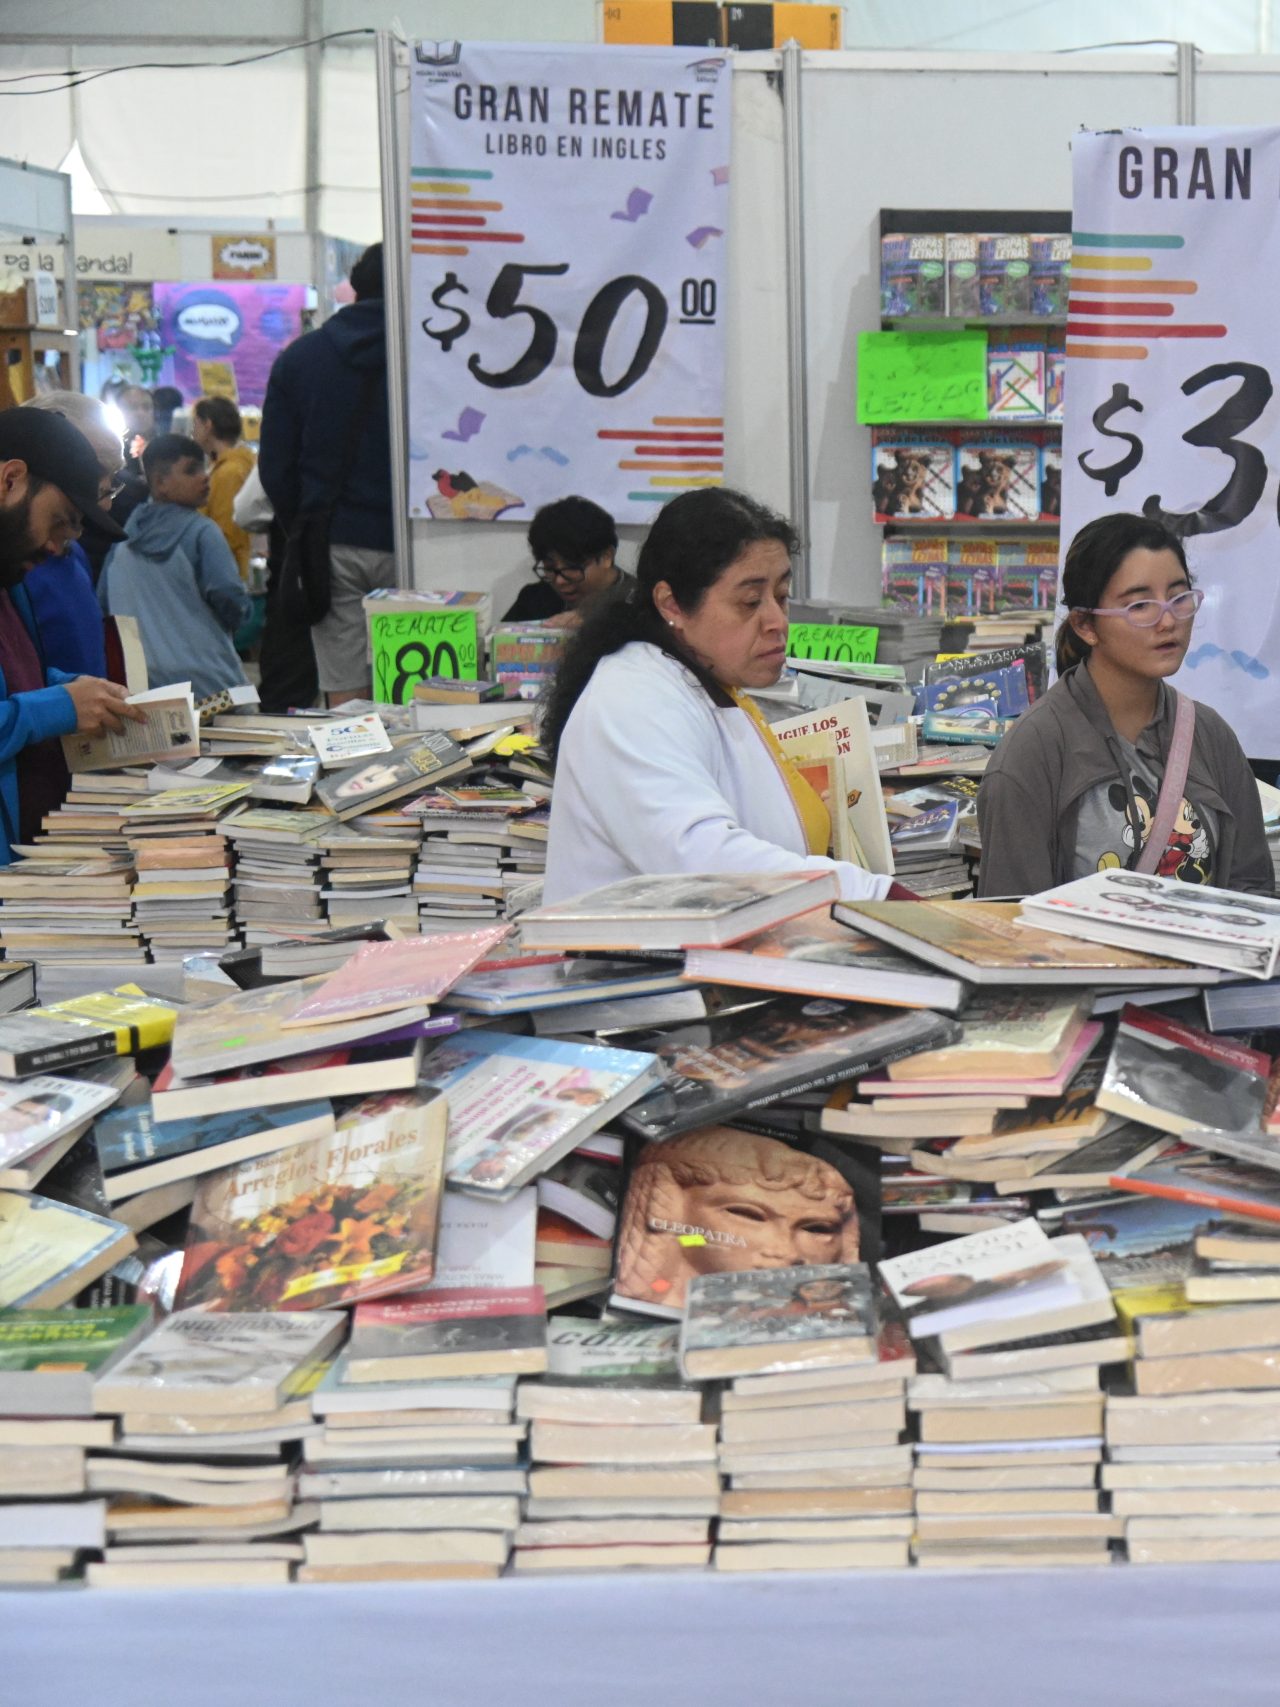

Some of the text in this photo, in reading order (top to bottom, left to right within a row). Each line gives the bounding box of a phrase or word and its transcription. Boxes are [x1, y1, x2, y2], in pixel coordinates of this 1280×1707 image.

[454, 83, 715, 129] GRAN REMATE
[485, 133, 667, 160] LIBRO EN INGLES
[1118, 145, 1252, 200] GRAN
[76, 252, 133, 275] anda!
[375, 612, 471, 639] REMATE
[812, 716, 838, 734] LOS
[227, 1128, 418, 1200] Arreglos Florales
[648, 1216, 748, 1248] CLEOPATRA
